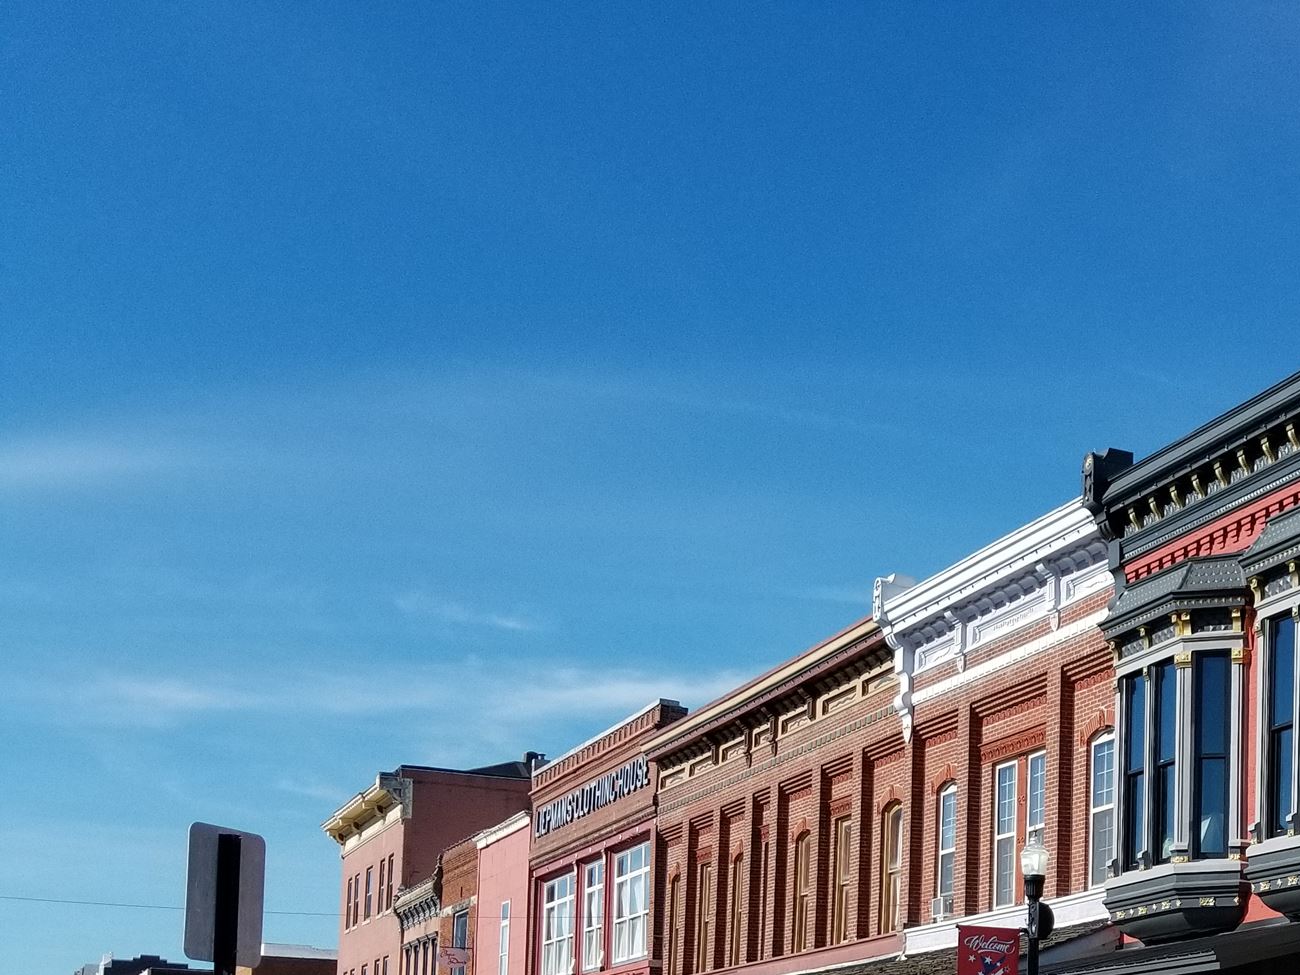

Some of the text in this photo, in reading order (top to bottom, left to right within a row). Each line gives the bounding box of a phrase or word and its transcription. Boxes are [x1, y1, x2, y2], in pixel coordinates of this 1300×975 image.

[573, 770, 618, 819] CLOTHING
[617, 755, 651, 799] HOUSE
[964, 935, 1015, 953] Welcome
